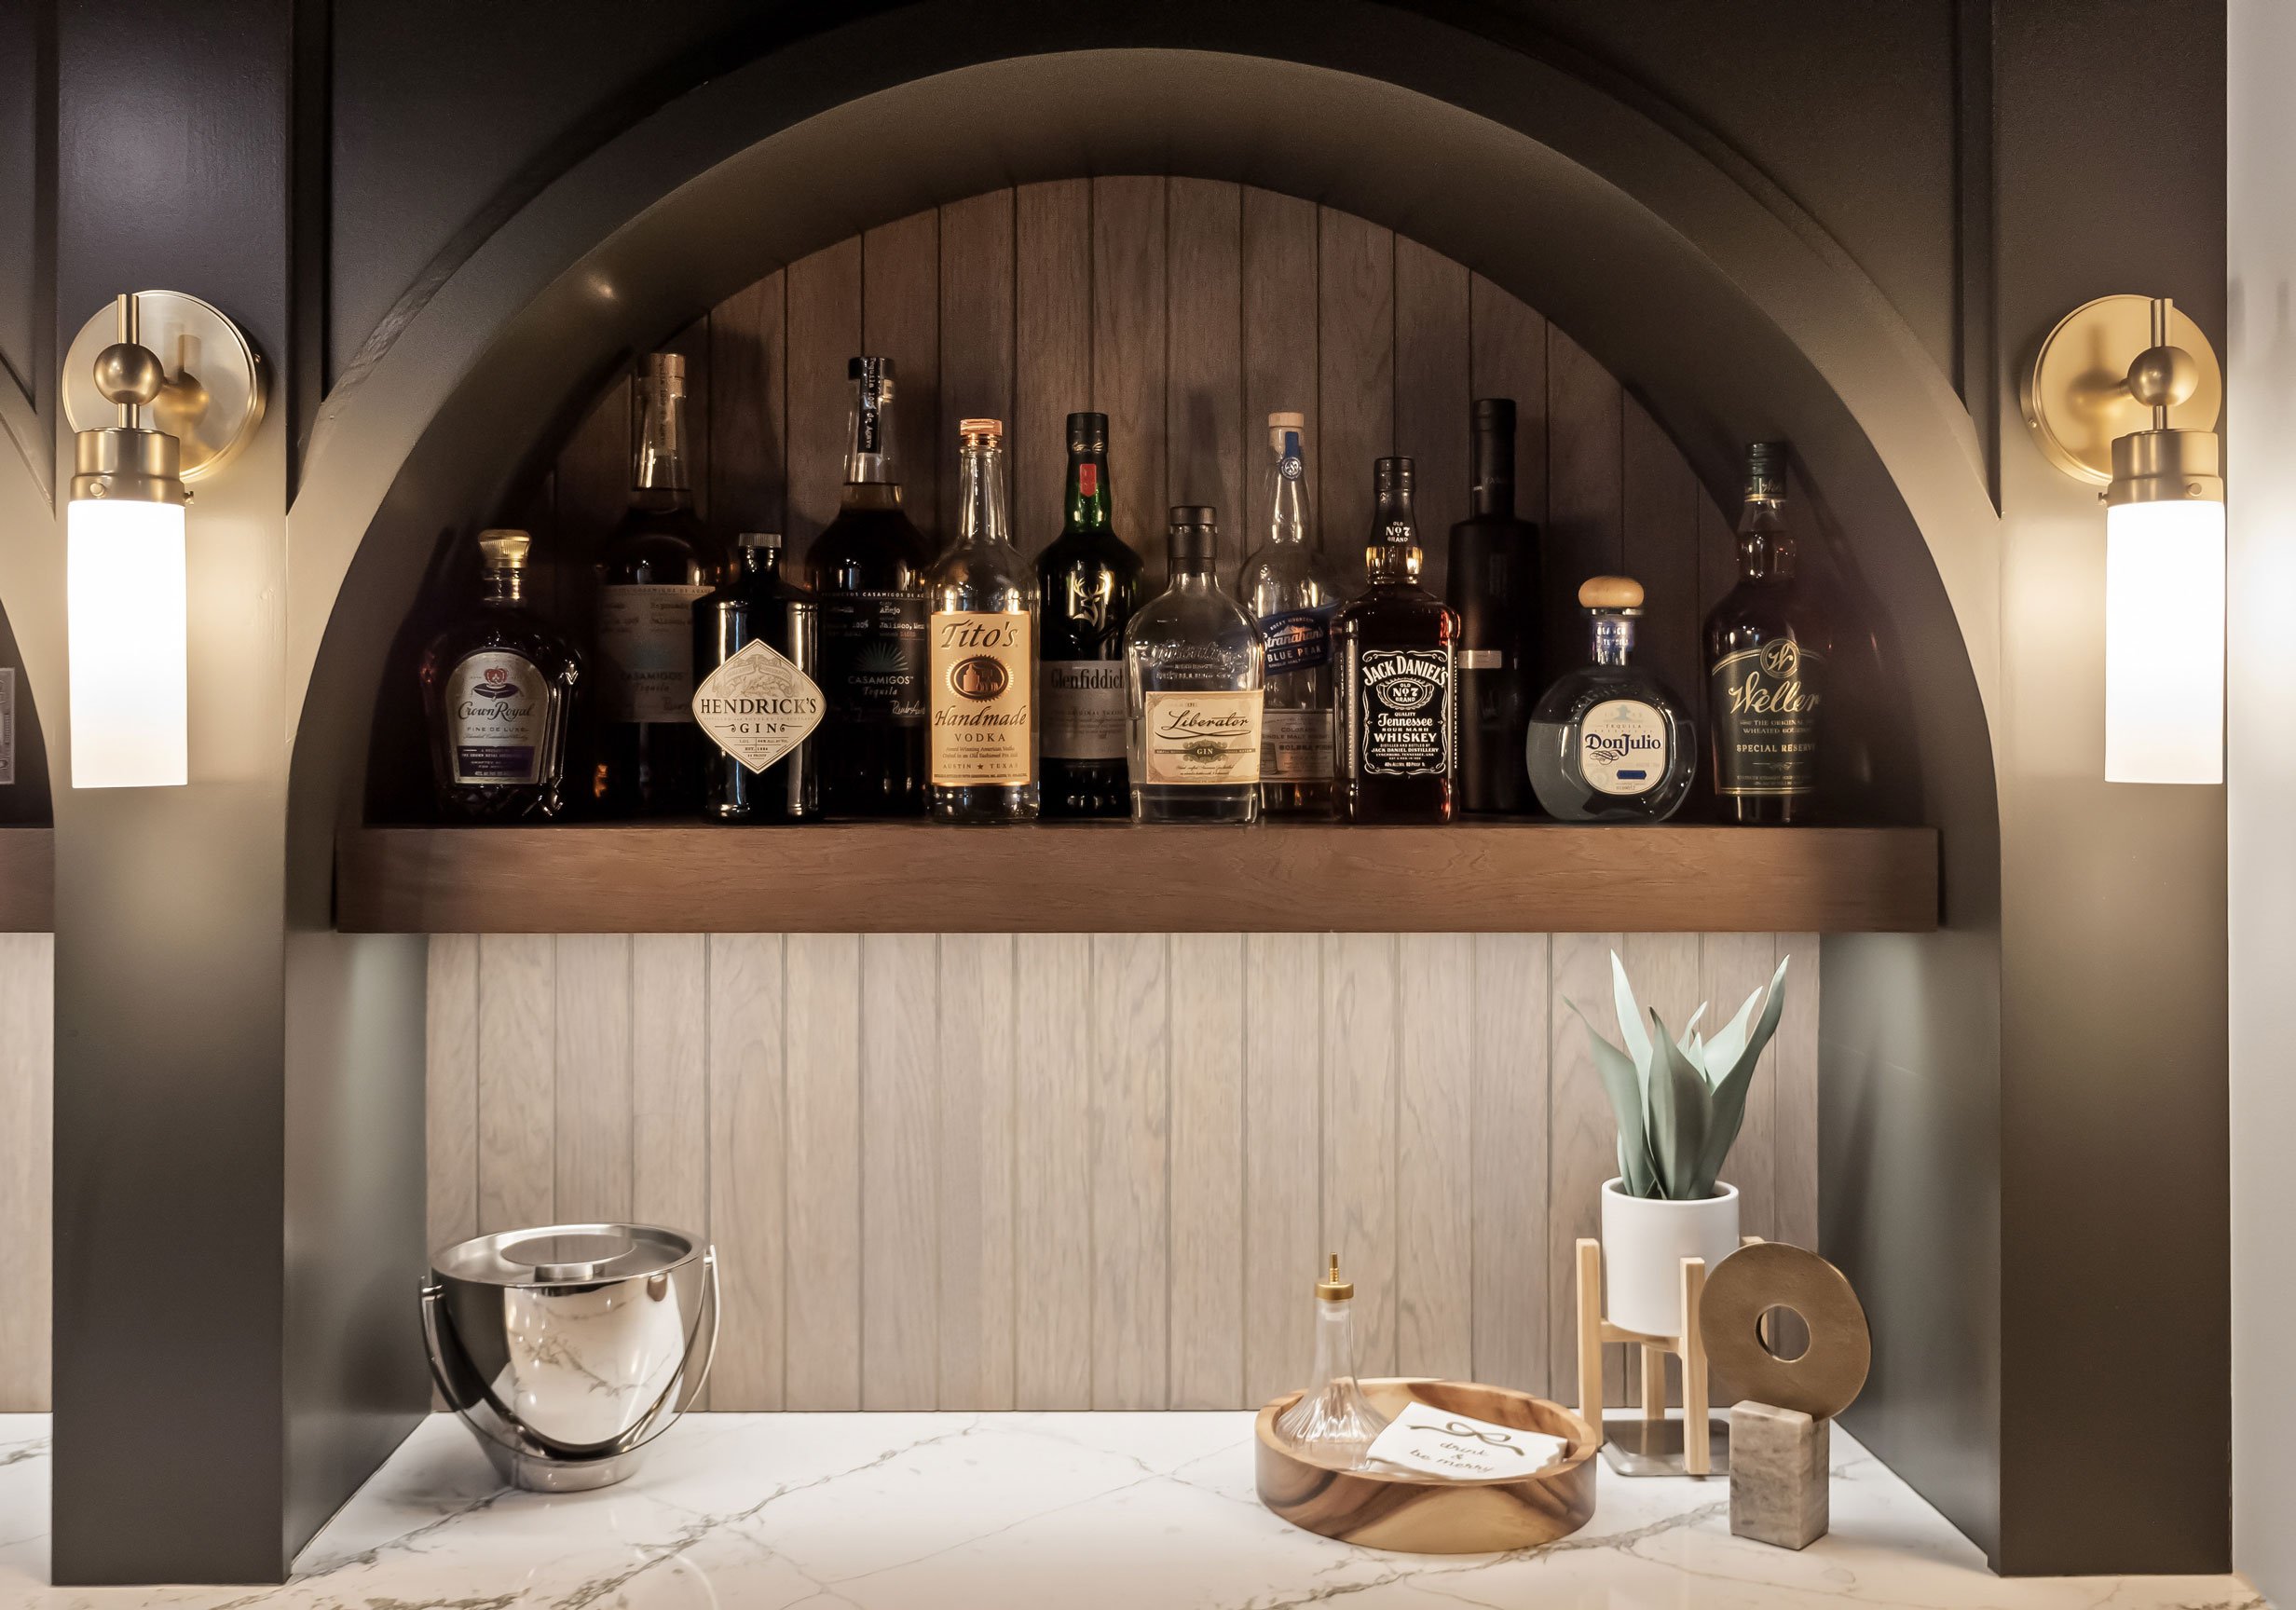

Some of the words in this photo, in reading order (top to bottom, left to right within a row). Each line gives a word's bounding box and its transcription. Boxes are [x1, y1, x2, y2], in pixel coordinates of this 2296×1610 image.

[1403, 526, 1411, 537] 7
[940, 619, 1018, 648] Tito's
[1266, 649, 1293, 662] BLUE
[1362, 660, 1397, 687] JACK
[1396, 655, 1448, 688] DANIEL'S
[848, 675, 910, 685] CASAMIGOS
[1410, 688, 1419, 697] 7
[1729, 671, 1821, 715] Weller
[458, 701, 495, 719] Crown
[488, 701, 534, 722] Royal
[701, 697, 817, 715] HENDRICK'S
[934, 705, 1027, 727] Handmade
[1161, 709, 1250, 731] Liberator
[1377, 713, 1433, 727] Tennessee
[740, 723, 778, 734] GIN
[954, 732, 1006, 743] VODKA
[1374, 732, 1437, 743] WHISKEY
[1736, 744, 1778, 753] SPECIAL
[1440, 1440, 1489, 1457] drink
[1409, 1449, 1430, 1461] be
[1436, 1458, 1495, 1473] merry
